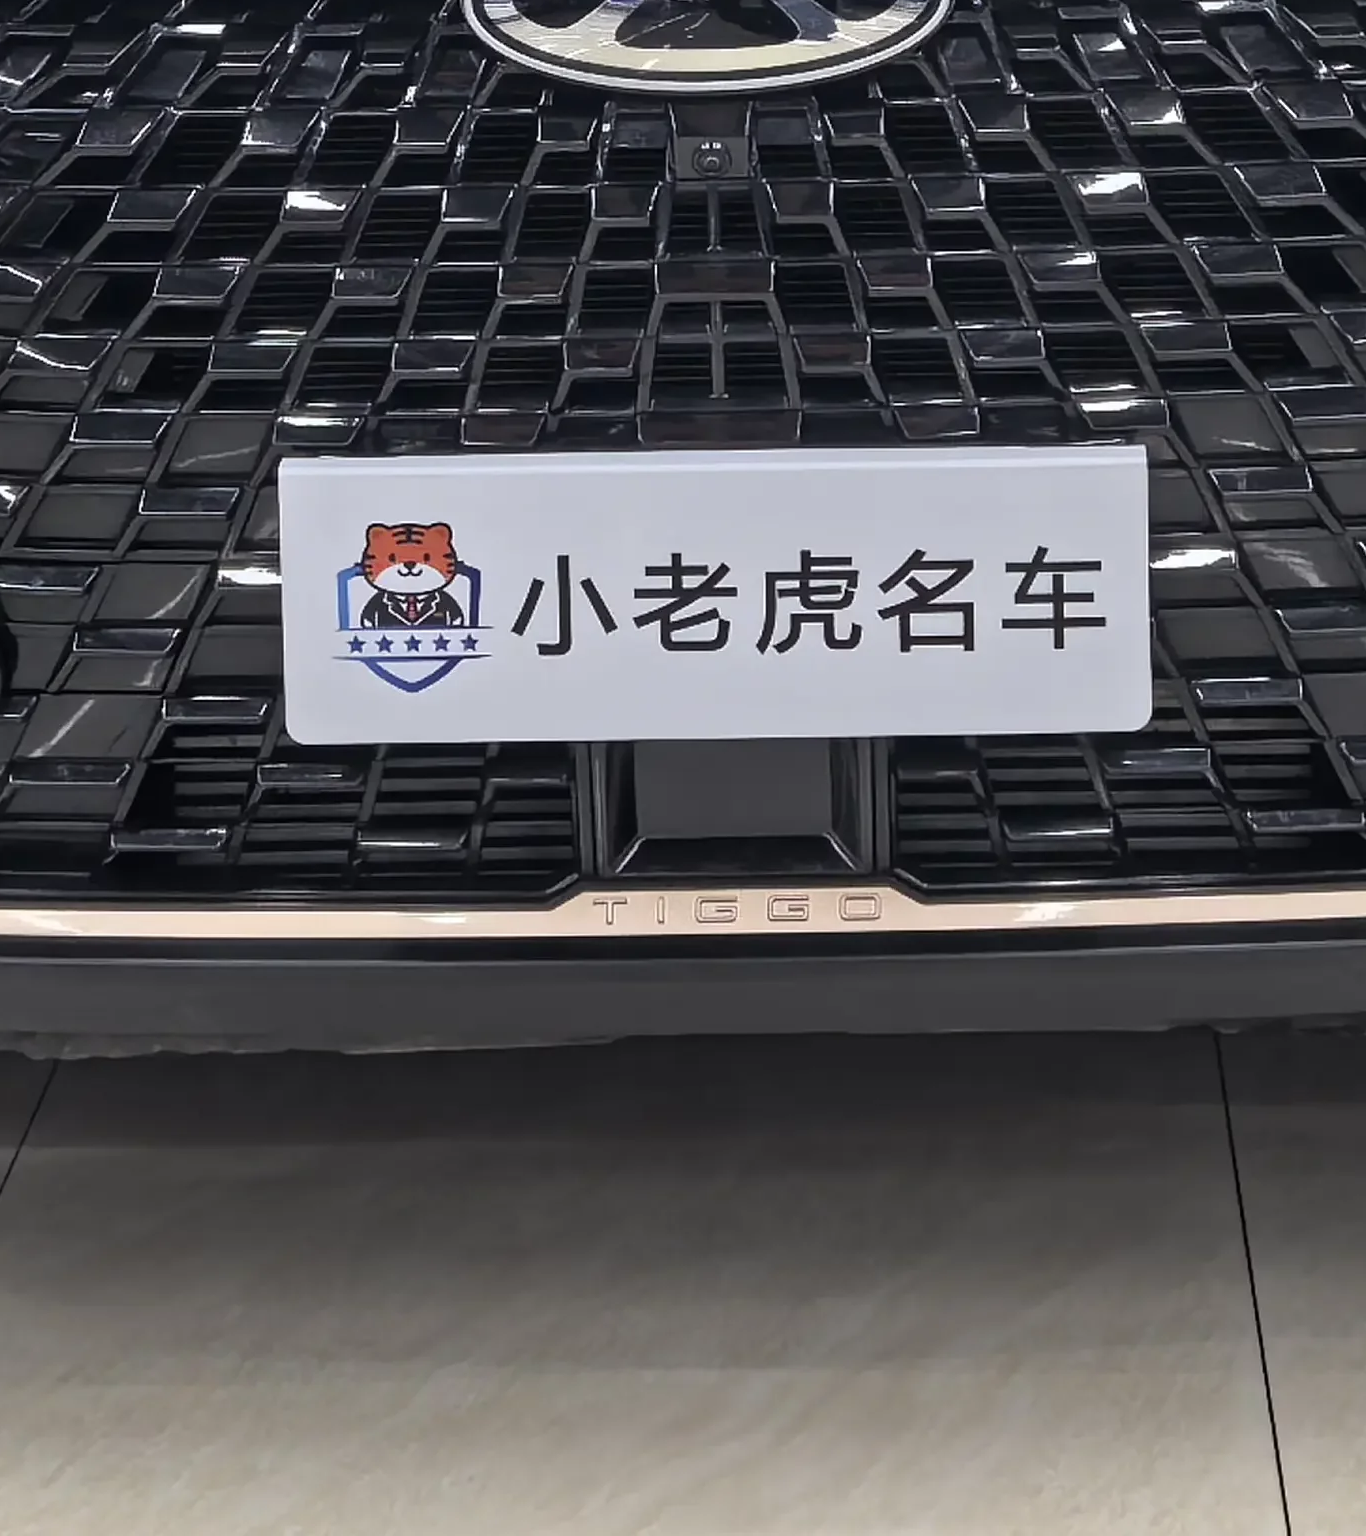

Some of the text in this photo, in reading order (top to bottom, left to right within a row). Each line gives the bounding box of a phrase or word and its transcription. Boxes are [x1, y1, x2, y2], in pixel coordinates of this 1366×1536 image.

[510, 545, 1108, 657] 小老虎名车
[592, 892, 883, 926] TIGGO
